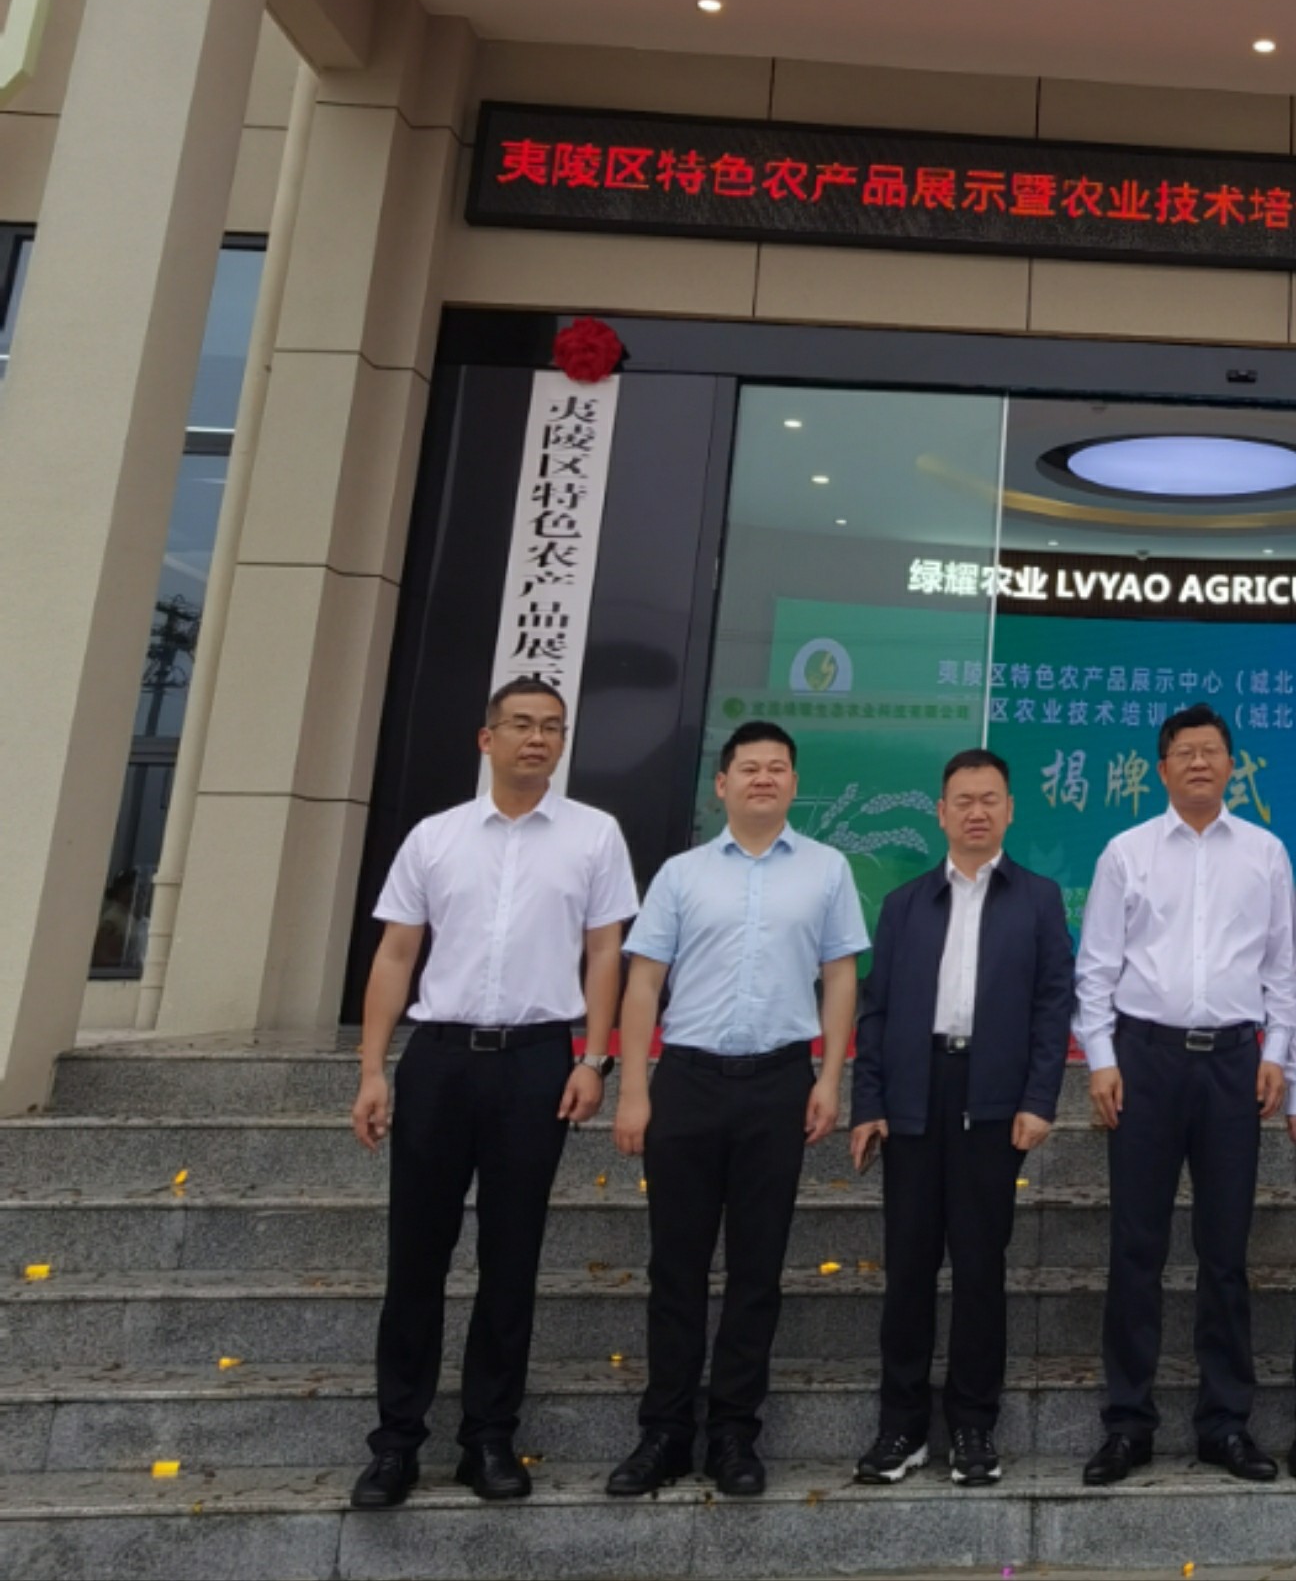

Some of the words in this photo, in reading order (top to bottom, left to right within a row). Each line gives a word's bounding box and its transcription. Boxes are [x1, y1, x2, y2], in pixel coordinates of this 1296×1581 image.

[907, 558, 1048, 601] 绿耀农业
[1056, 569, 1171, 602] LVYAO
[1040, 748, 1271, 824] 揭牌式
